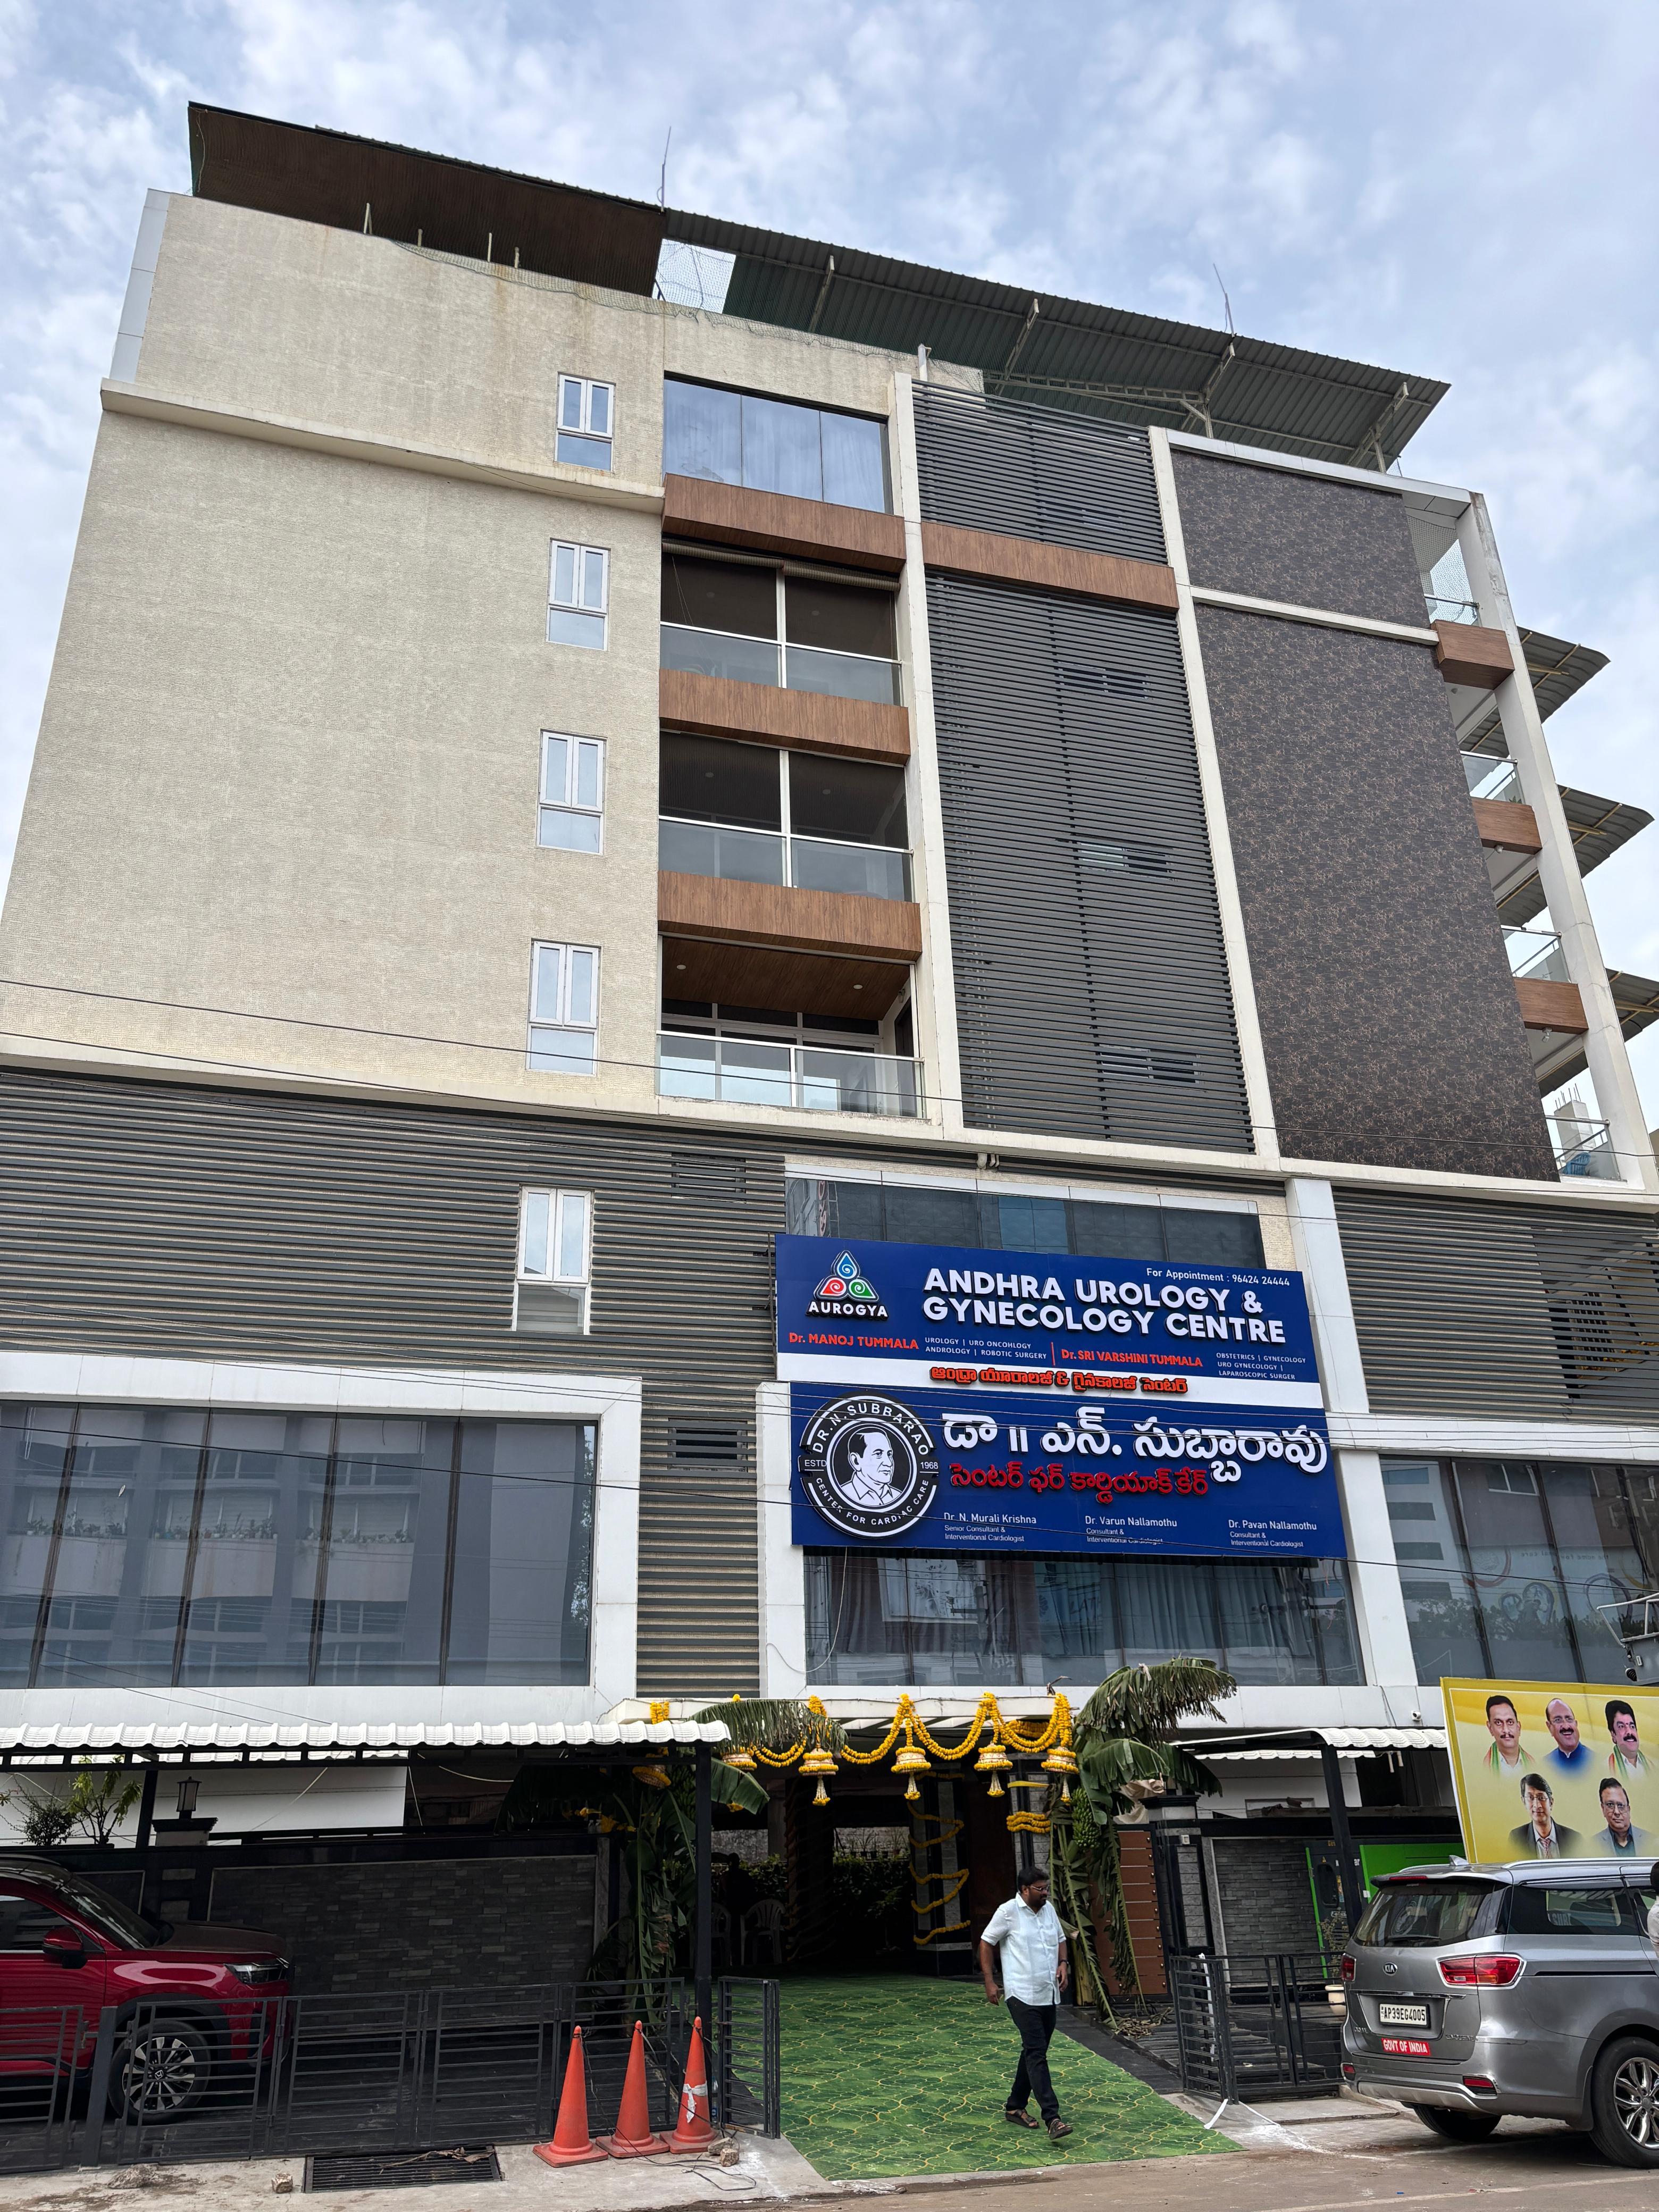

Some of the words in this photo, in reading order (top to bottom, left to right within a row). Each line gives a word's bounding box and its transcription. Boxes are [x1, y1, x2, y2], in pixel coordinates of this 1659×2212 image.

[1146, 1268, 1162, 1277] For
[1166, 1269, 1224, 1282] Appointment
[1232, 1274, 1259, 1284] 96424
[1262, 1276, 1290, 1286] 24444
[924, 1268, 1066, 1301] ANDHRA
[1075, 1278, 1230, 1311] UROLOGY
[1243, 1291, 1263, 1313] &
[808, 1301, 888, 1317] AUROGYA
[923, 1296, 1154, 1334] GYNECOLOGY
[1166, 1313, 1286, 1343] CENTRE
[789, 1333, 805, 1343] Dr.
[809, 1334, 853, 1346] MANOJ
[858, 1337, 919, 1350] TUMMALA
[987, 1341, 1031, 1350] ONCOHLOGY
[925, 1346, 970, 1355] ANDROLOGY
[1061, 1349, 1076, 1360] Dr.
[1078, 1350, 1094, 1361] SRI
[1097, 1351, 1148, 1364] VARSHINI
[1150, 1354, 1203, 1367] TUMMALA
[1219, 1370, 1267, 1378] LAPAROSCOPIC
[816, 1477, 843, 1513] CENTER
[847, 1512, 866, 1524] FOR
[871, 1506, 912, 1525] CARDIAC
[913, 1480, 929, 1505] CARE
[959, 1513, 969, 1522] N.
[971, 1513, 999, 1523] Murali
[1002, 1514, 1037, 1524] Krishna
[1085, 1515, 1097, 1524] Dr.
[1100, 1516, 1125, 1525] Varun
[1128, 1517, 1177, 1527] Nallamothu
[1228, 1520, 1241, 1528] Dr.
[1242, 1520, 1267, 1529] Pavan
[1269, 1521, 1317, 1530] Nallamothu
[1384, 2007, 1426, 2021] AP39EG4005
[1383, 2039, 1398, 2051] GOVT
[1399, 2041, 1408, 2051] OF
[1409, 2042, 1428, 2053] INDIA
